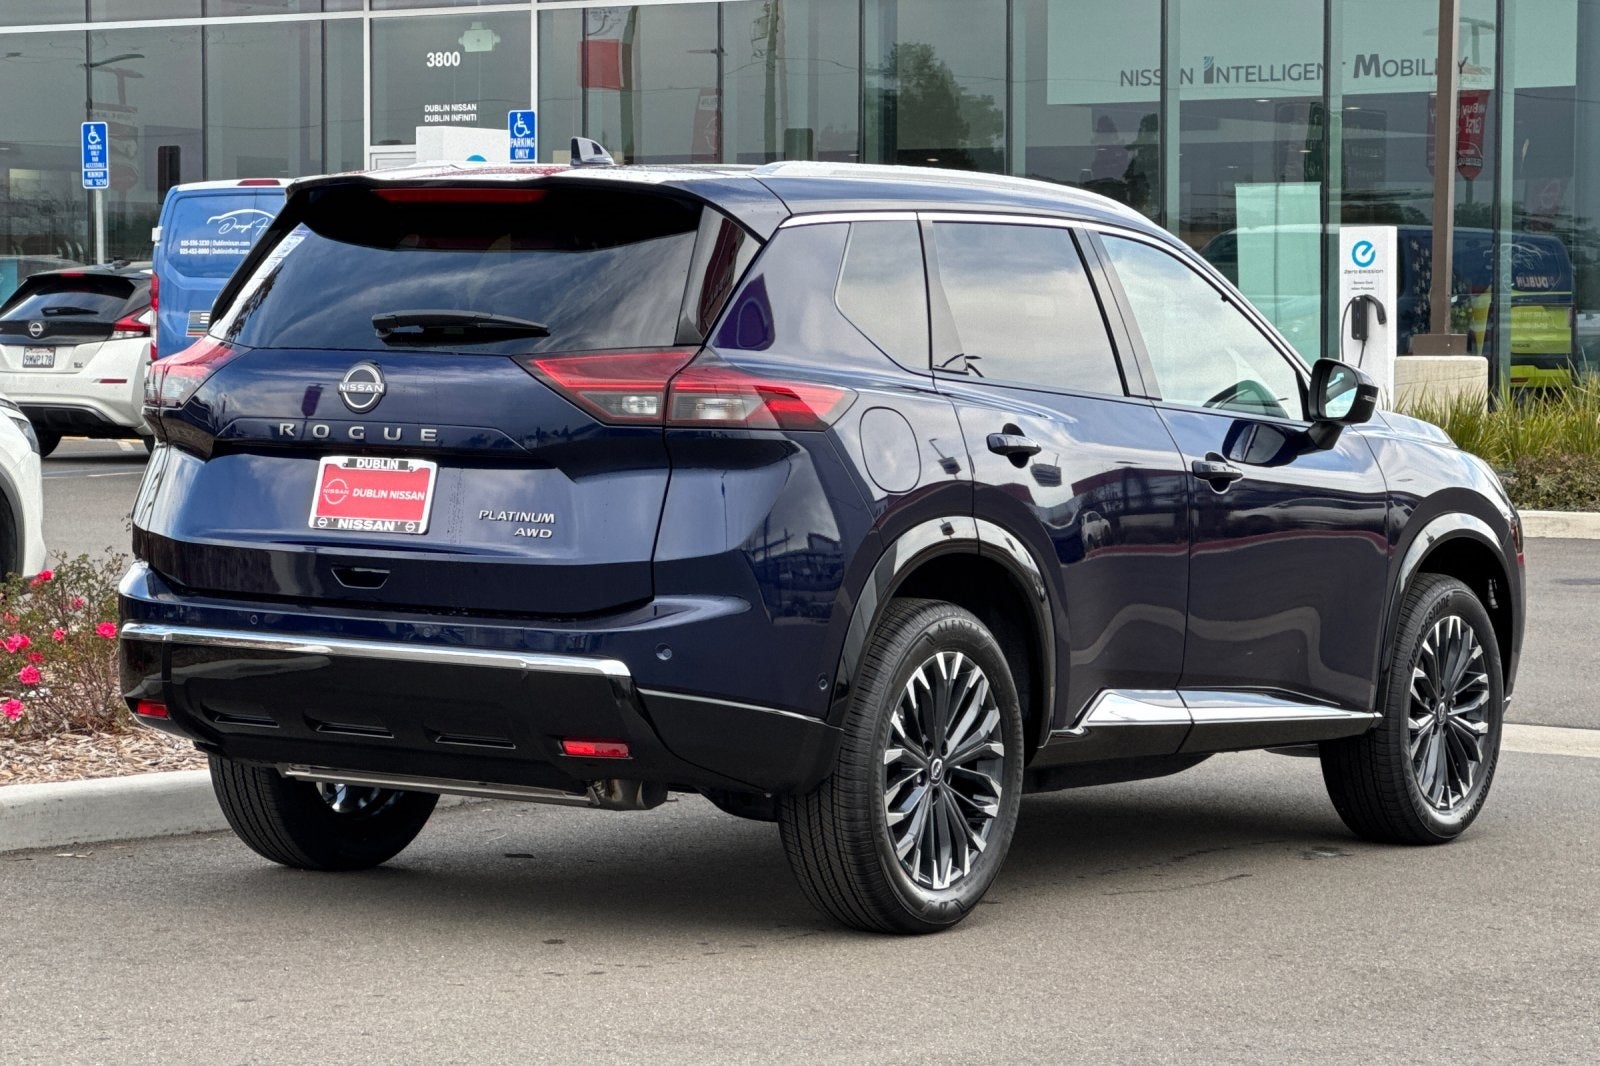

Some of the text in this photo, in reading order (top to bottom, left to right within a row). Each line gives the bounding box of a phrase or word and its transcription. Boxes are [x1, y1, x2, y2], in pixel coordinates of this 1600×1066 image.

[426, 52, 461, 67] 3800
[1120, 68, 1194, 87] NISSN
[1353, 54, 1468, 79] MOBILIY
[424, 103, 477, 112] DUBLIN NISSAN
[424, 113, 477, 122] DUBLIN INFINITI
[510, 138, 534, 147] PARKING
[515, 149, 529, 158] ONLY
[339, 383, 384, 393] NISSAN
[279, 423, 437, 442] ROGUE
[356, 458, 398, 470] DUBLIN
[352, 488, 425, 500] DUBLIN NISSAN
[479, 510, 555, 524] PLATINUM
[337, 518, 395, 531] NISSAN
[514, 527, 552, 538] AWD
